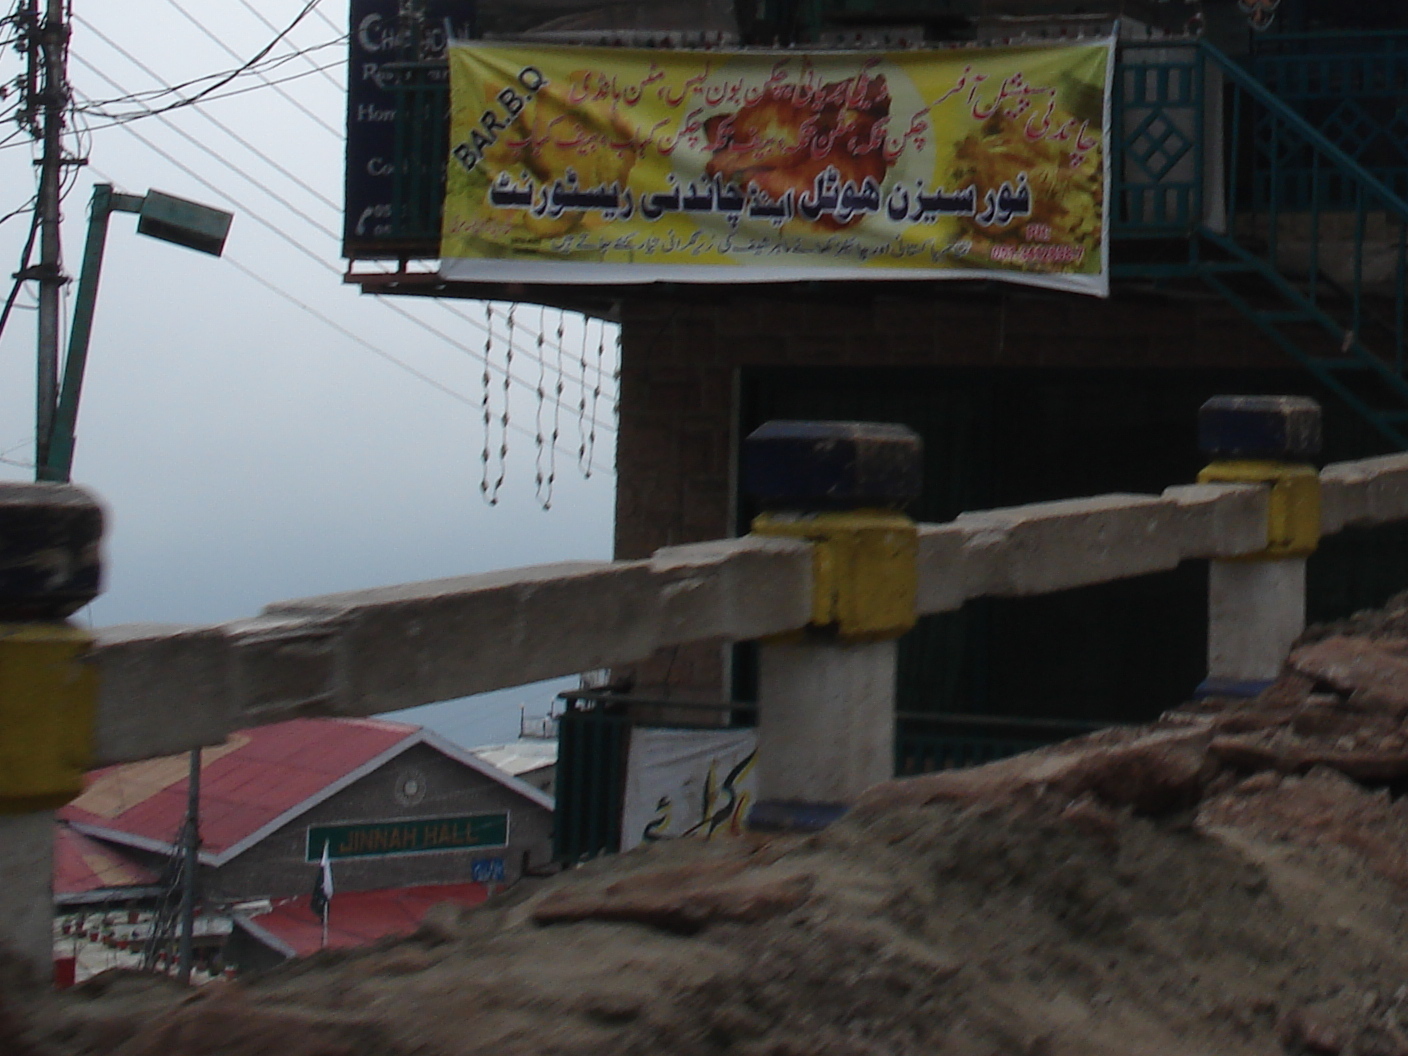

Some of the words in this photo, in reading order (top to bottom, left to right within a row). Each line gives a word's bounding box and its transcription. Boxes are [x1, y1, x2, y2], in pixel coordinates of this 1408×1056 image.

[1024, 87, 1099, 169] چاندنی
[488, 166, 636, 222] ریسٹورنٹ
[640, 170, 746, 229] چاندنی
[887, 177, 977, 225] سیزن
[976, 171, 1033, 228] فور
[338, 825, 419, 854] JINNAH
[422, 820, 481, 845] HALL
